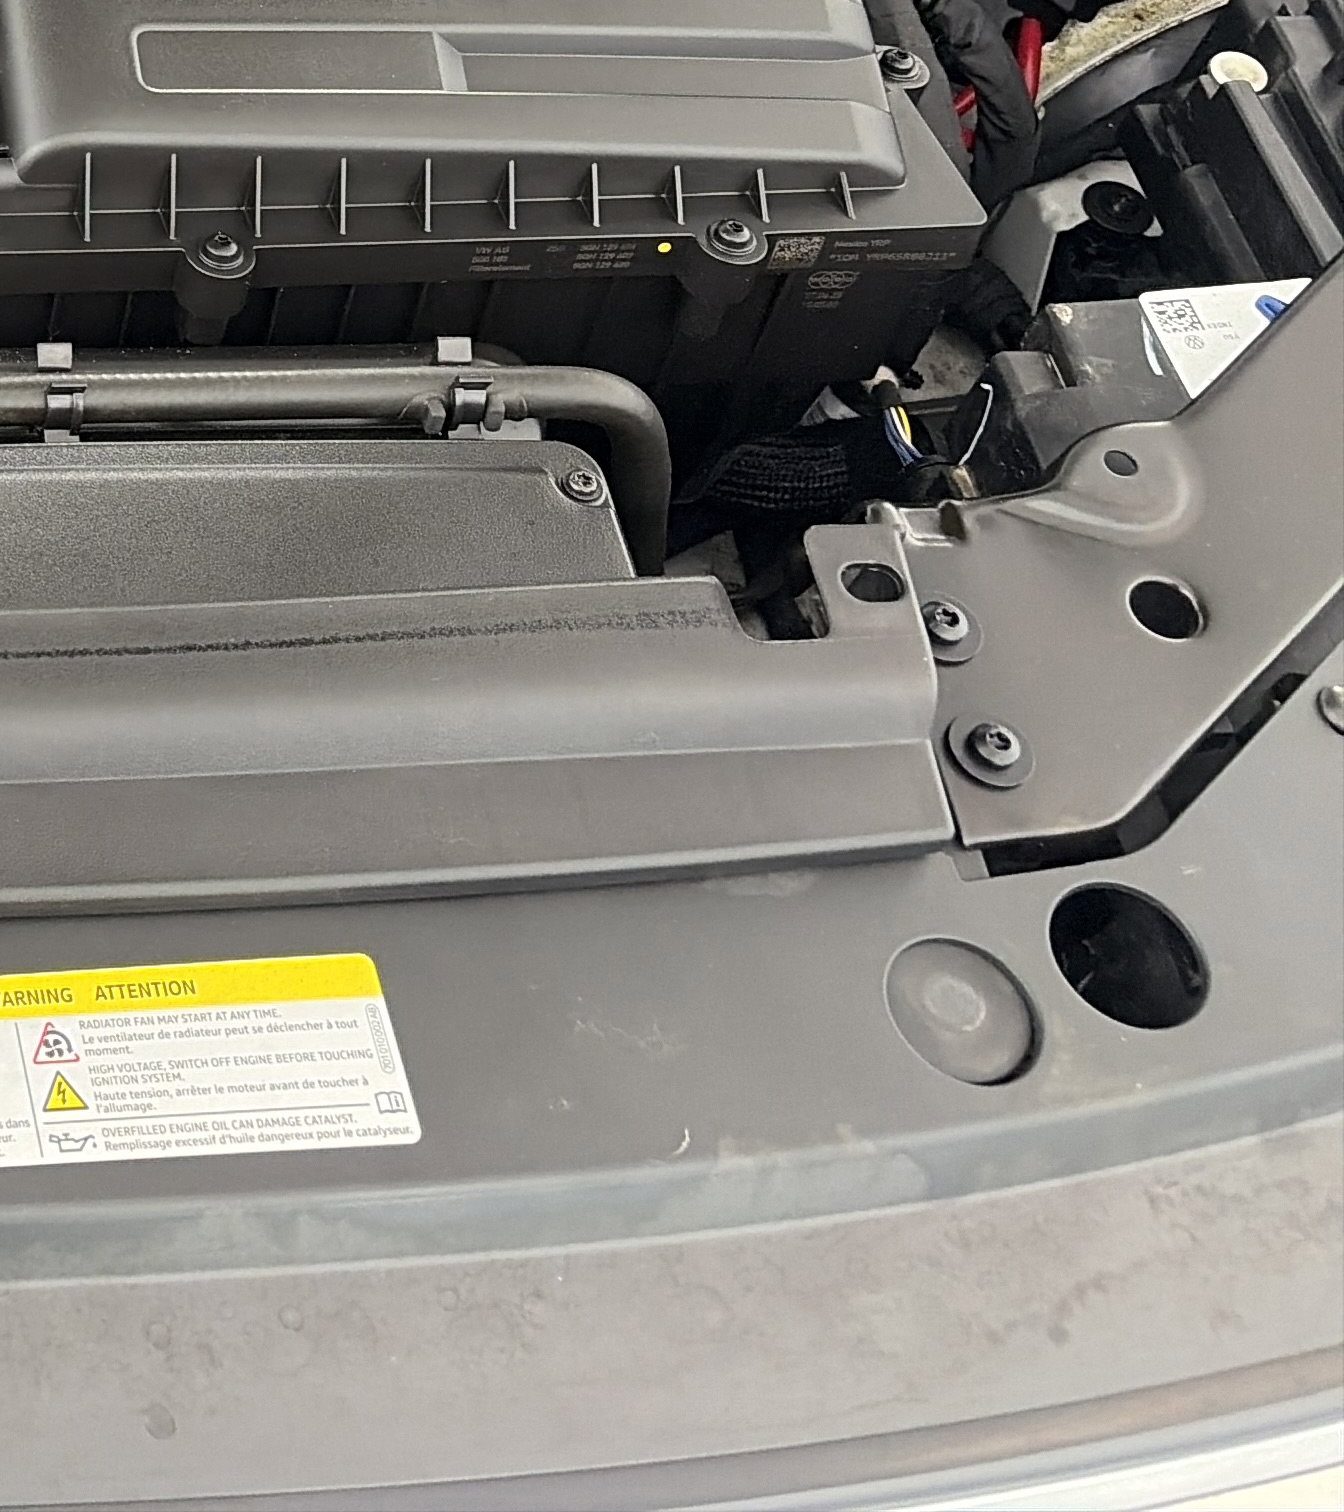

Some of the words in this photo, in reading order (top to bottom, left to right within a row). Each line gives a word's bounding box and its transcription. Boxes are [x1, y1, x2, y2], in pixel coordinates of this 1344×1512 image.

[95, 980, 197, 1001] ATTENTION
[79, 1017, 131, 1030] RADIATOR
[133, 1015, 155, 1027] FAN
[157, 1014, 179, 1025] MAY
[181, 1011, 213, 1023] START
[215, 1010, 228, 1021] AT
[230, 1010, 253, 1020] ANY
[253, 1008, 282, 1019] TIME.
[81, 1034, 95, 1044] Le
[98, 1031, 155, 1044] ventilateur
[158, 1030, 171, 1040] de
[173, 1026, 222, 1039] radiateur
[225, 1024, 249, 1037] peut
[252, 1025, 263, 1034] se
[266, 1020, 324, 1033] déclencher
[326, 1019, 333, 1030] à
[335, 1019, 359, 1029] tout
[84, 1045, 134, 1057] moment.
[88, 1063, 115, 1075] HIGH
[116, 1061, 167, 1074] VOLTAGE,
[168, 1058, 209, 1070] SWITCH
[211, 1056, 230, 1068] OFF
[234, 1054, 273, 1066] ENGINE
[275, 1051, 317, 1064] BEFORE
[318, 1048, 374, 1061] TOUCHING
[90, 1074, 139, 1087] IGNITION
[141, 1072, 185, 1084] SYSTEM.
[94, 1090, 127, 1102] Haute
[129, 1087, 173, 1100] tension,
[175, 1085, 212, 1097] arrêter
[215, 1084, 225, 1095] le
[227, 1082, 266, 1094] moteur
[269, 1080, 299, 1091] avant
[302, 1078, 315, 1089] de
[317, 1076, 359, 1088] toucher
[362, 1075, 369, 1086] à
[96, 1102, 157, 1114] l'allumage.
[6, 1118, 31, 1129] dans
[101, 1123, 167, 1138] OVERFILLED
[169, 1121, 209, 1134] ENGINE
[211, 1120, 229, 1131] OIL
[231, 1119, 255, 1130] CAN
[256, 1116, 302, 1129] DAMAGE
[304, 1113, 358, 1126] CATALYST.
[104, 1138, 172, 1152] Remplissage
[175, 1136, 216, 1148] excessif
[219, 1132, 255, 1145] d'huile
[258, 1131, 314, 1144] dangereux
[316, 1129, 342, 1141] pour
[343, 1127, 354, 1138] le
[356, 1125, 414, 1138] catalyseur.
